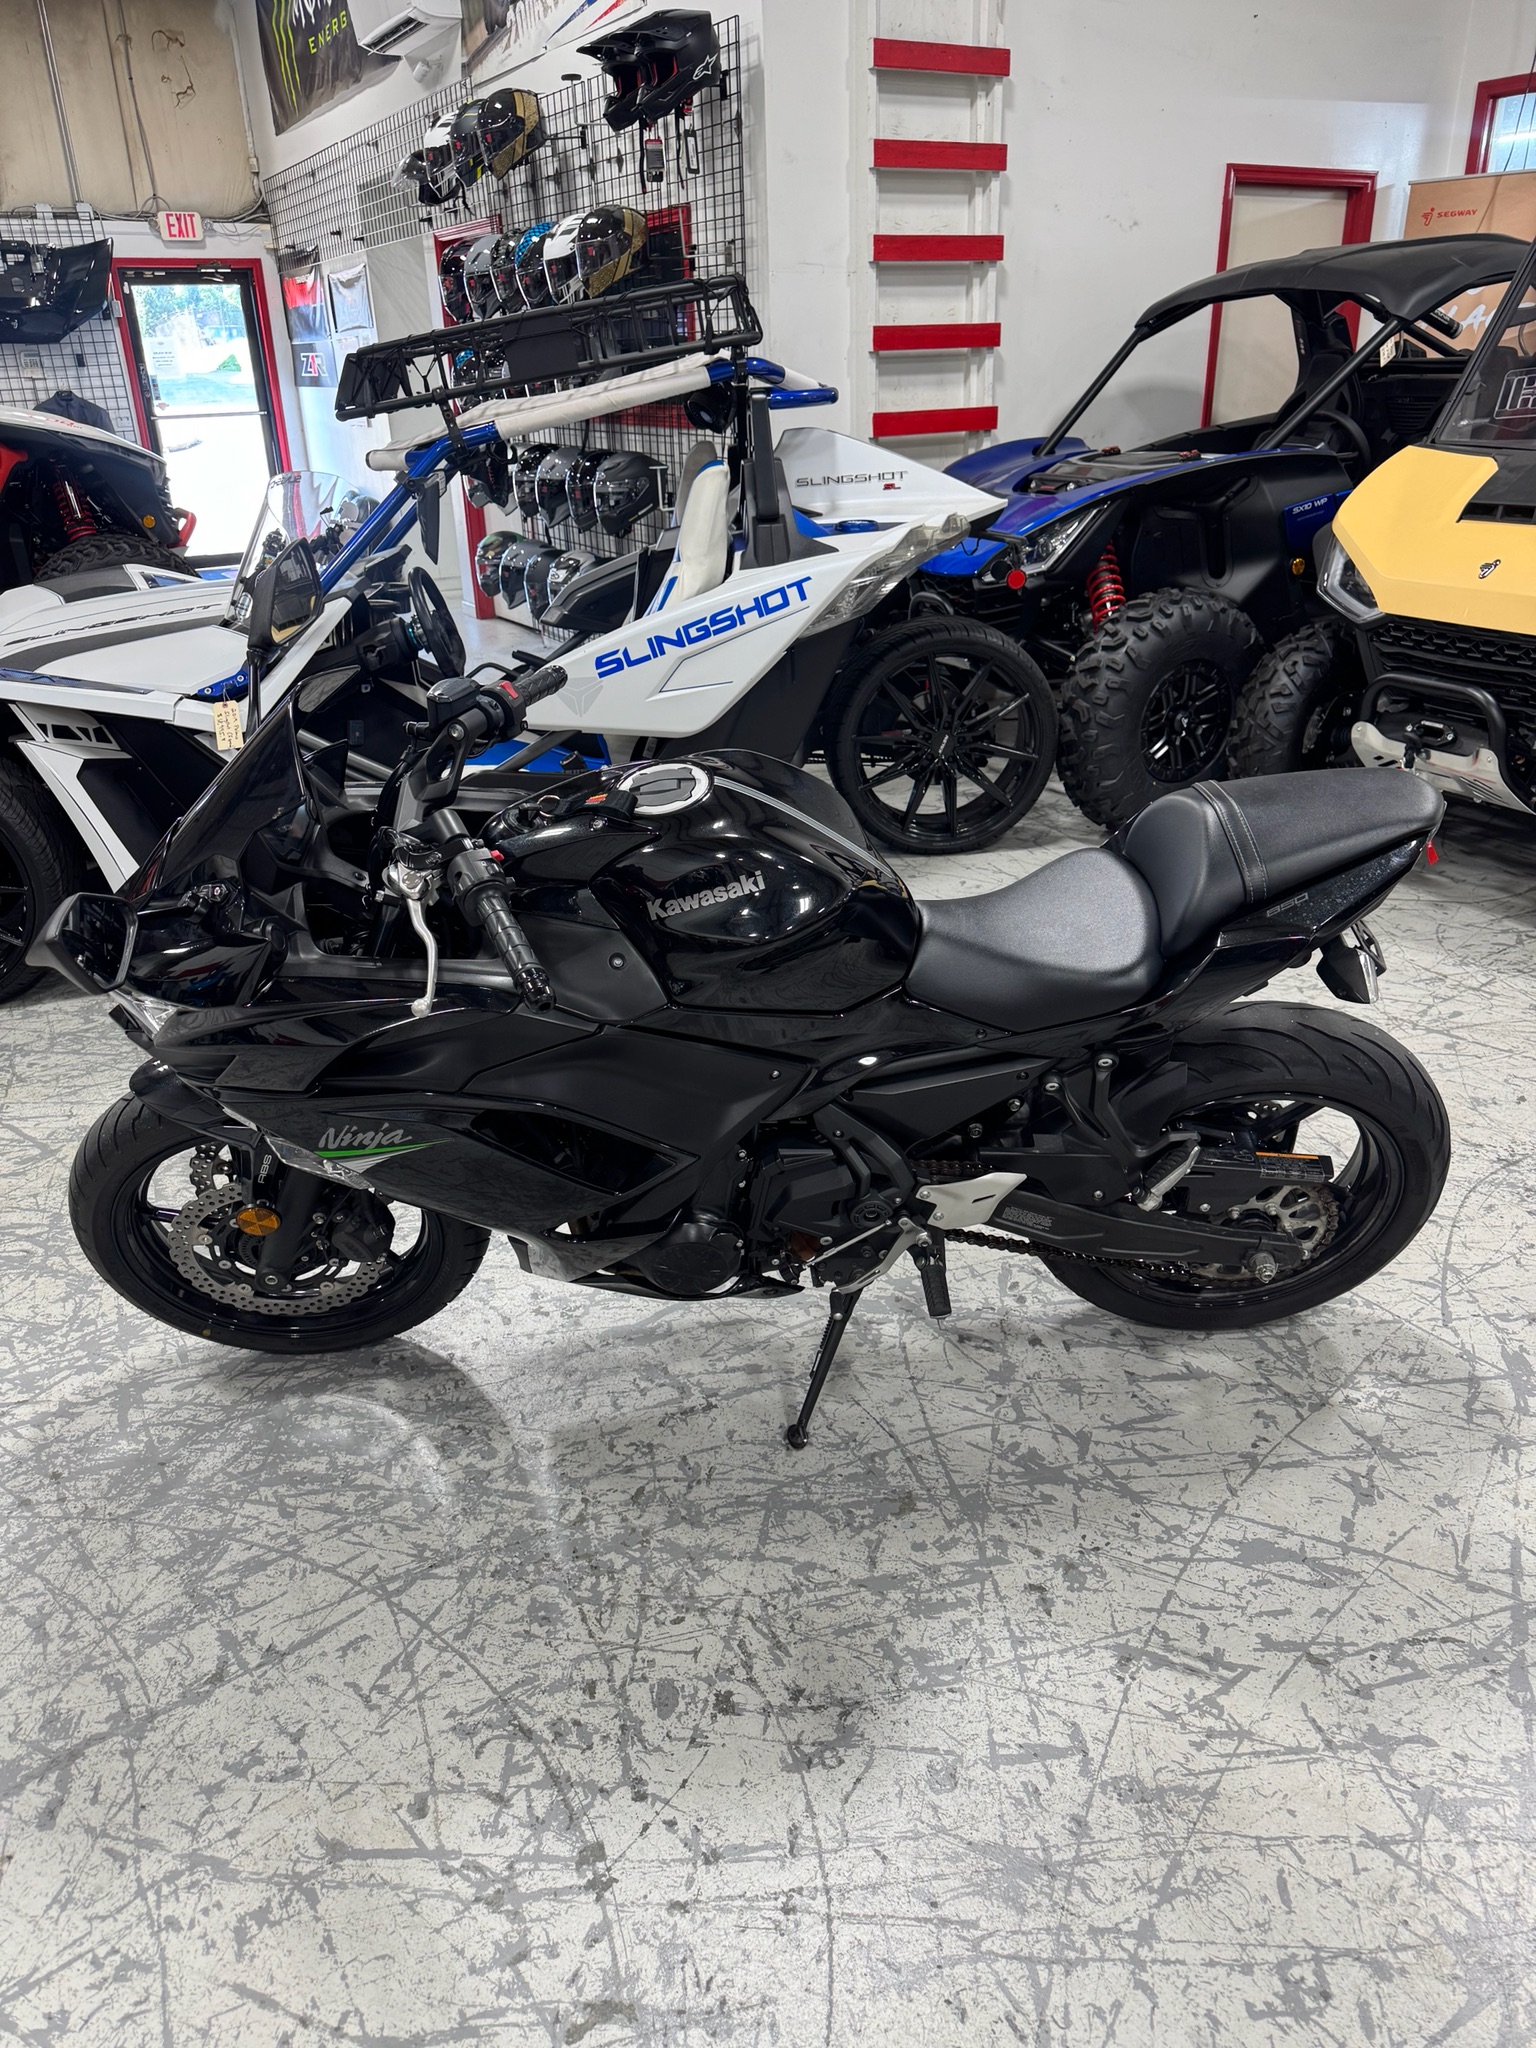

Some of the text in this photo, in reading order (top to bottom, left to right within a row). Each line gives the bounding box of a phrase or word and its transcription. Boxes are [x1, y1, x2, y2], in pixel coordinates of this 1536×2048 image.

[308, 10, 347, 54] ENERG
[165, 213, 196, 238] EXIT
[1436, 209, 1478, 218] SEGWAY
[796, 471, 908, 488] SLINGSHOT
[1292, 497, 1328, 515] SX10 WP
[4, 603, 223, 647] SLINGSHOT
[595, 576, 812, 678] SLINGSHOT
[646, 870, 766, 921] Kawasaki
[1266, 892, 1309, 918] 650
[318, 1122, 412, 1150] Ninja
[257, 1154, 272, 1184] ABS
